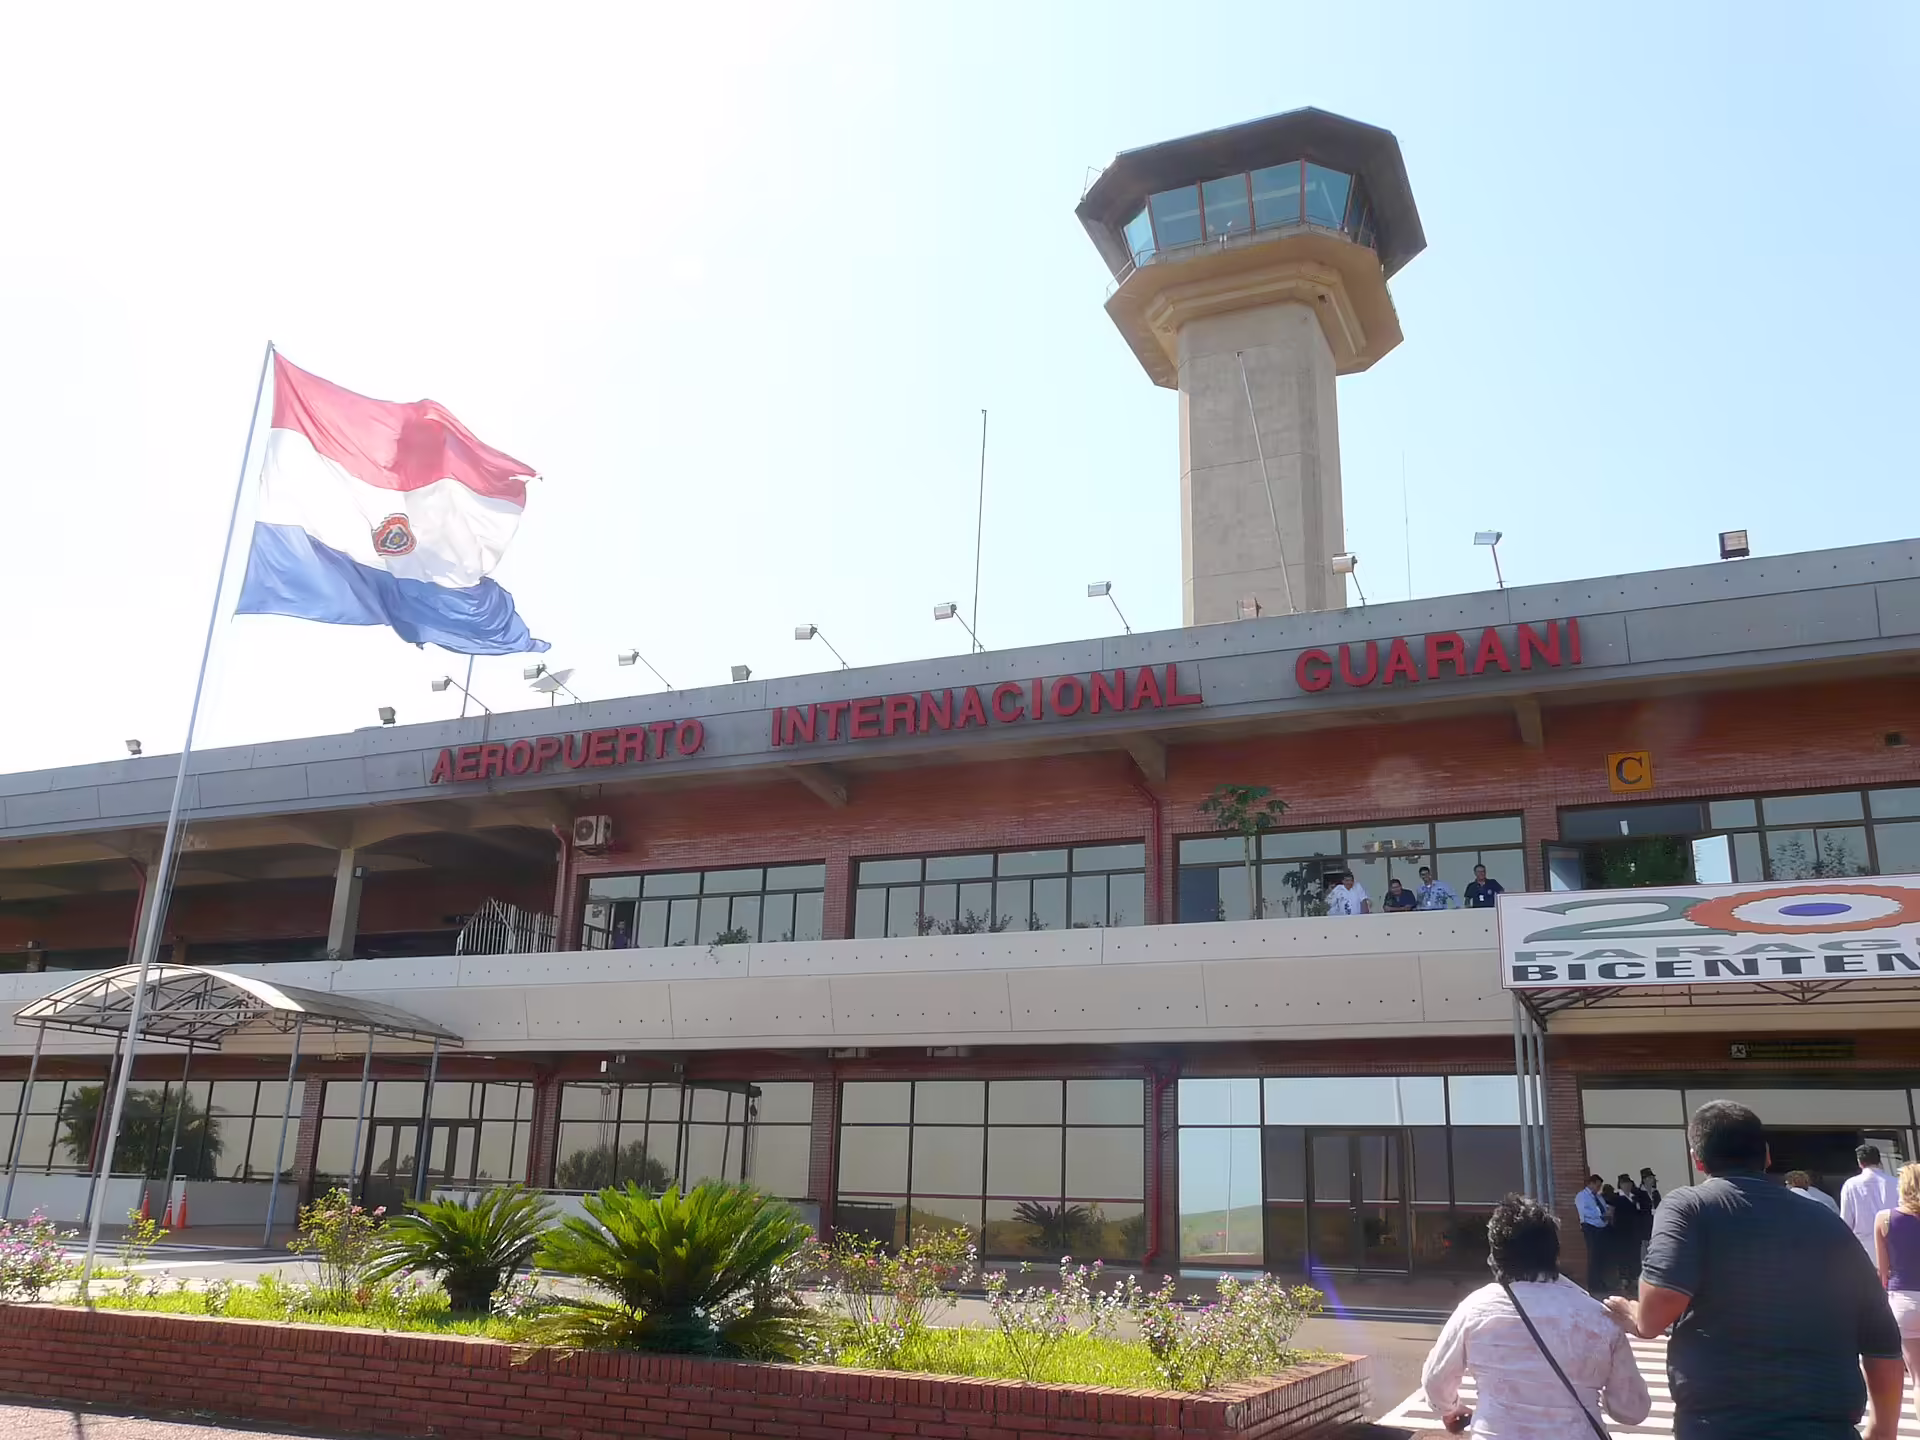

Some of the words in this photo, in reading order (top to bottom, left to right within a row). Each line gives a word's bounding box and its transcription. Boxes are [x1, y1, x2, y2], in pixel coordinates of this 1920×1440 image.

[430, 718, 704, 784] AEROPUERTO
[772, 664, 1202, 747] INTERNACIONAL
[1295, 617, 1582, 692] GUARANI
[1615, 757, 1644, 786] C
[1514, 937, 1919, 962] PARAG
